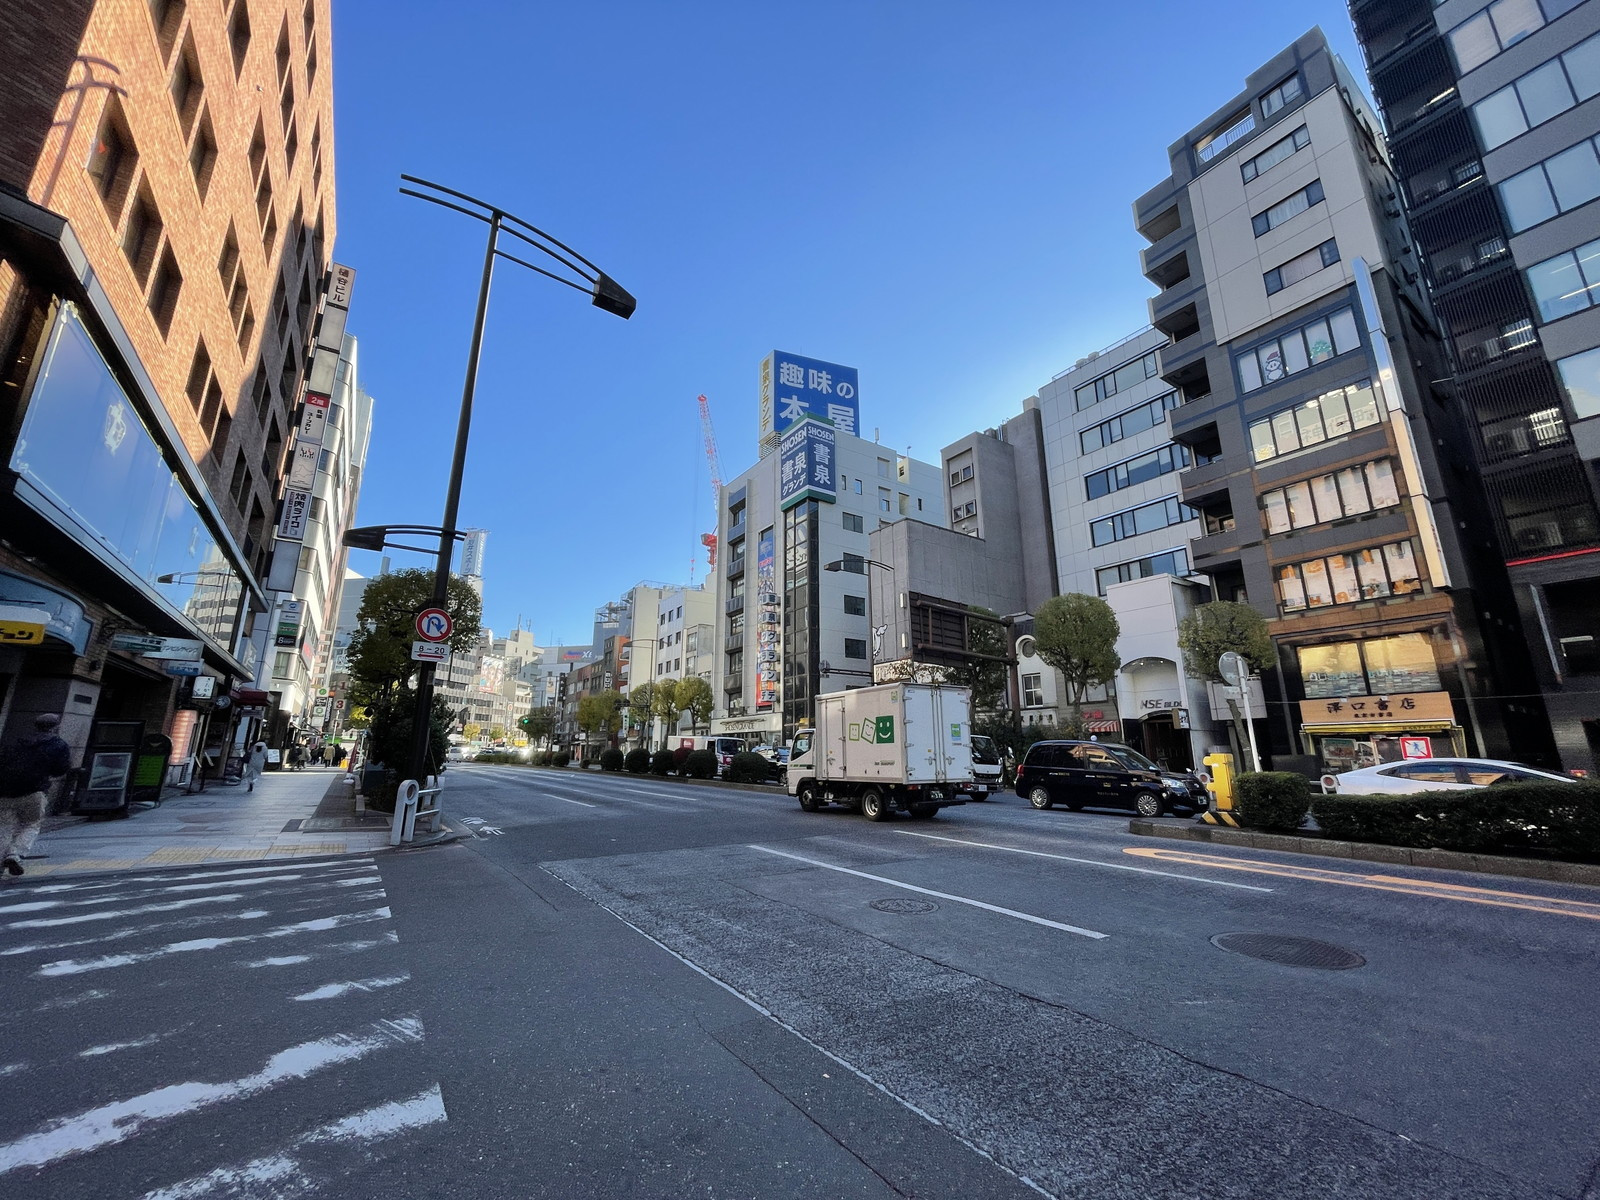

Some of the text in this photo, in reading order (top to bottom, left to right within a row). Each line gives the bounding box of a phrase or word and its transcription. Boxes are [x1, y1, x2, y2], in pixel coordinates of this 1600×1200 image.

[779, 362, 855, 399] 趣味の
[779, 395, 856, 436] 本屋
[781, 426, 807, 454] SHOSEN
[807, 425, 835, 442] SHOSEN
[781, 452, 807, 485] 書泉
[814, 443, 831, 485] 書泉
[1140, 699, 1163, 709] NSE
